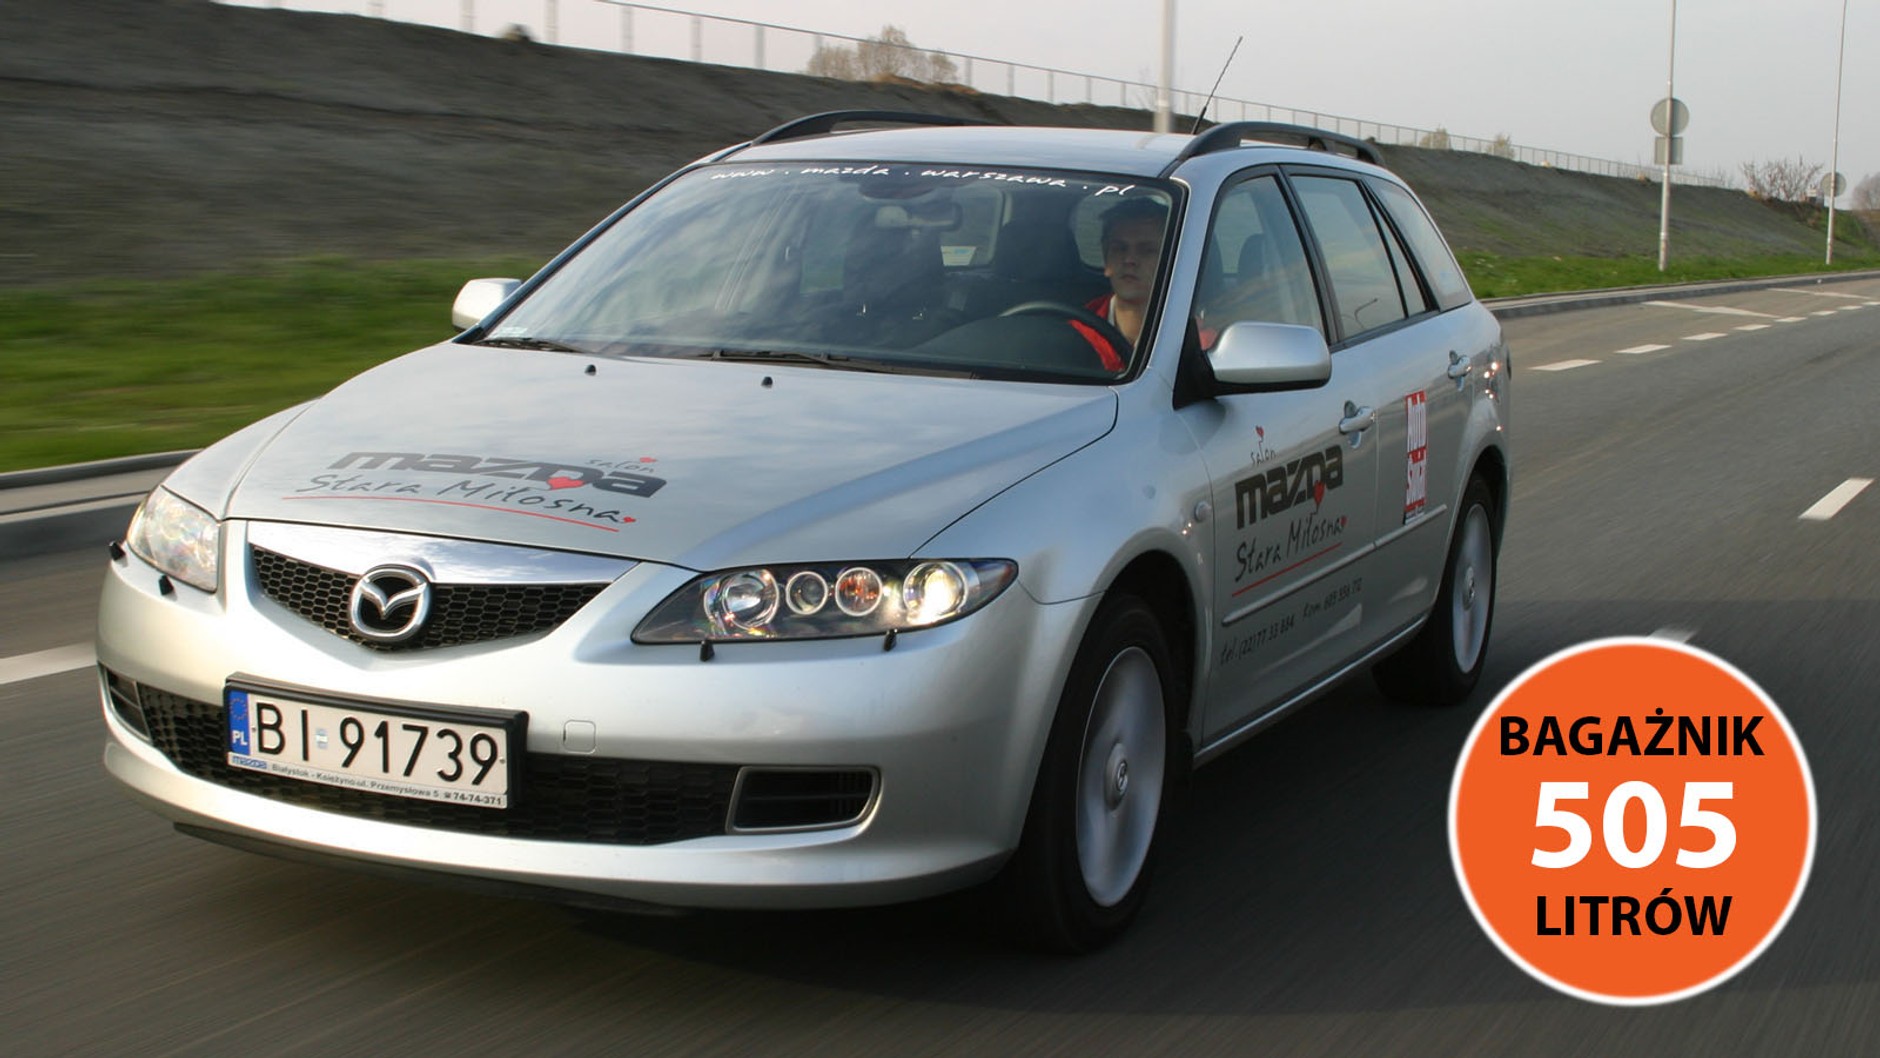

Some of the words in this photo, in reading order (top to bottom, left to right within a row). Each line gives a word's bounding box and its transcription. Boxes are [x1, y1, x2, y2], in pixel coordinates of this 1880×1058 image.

[295, 473, 420, 494] Stara
[436, 479, 622, 524] Miłosna
[1234, 537, 1282, 583] Stara
[1287, 514, 1344, 559] Miłosna
[231, 729, 249, 747] PL
[255, 701, 310, 762] BI
[338, 715, 499, 786] 91739
